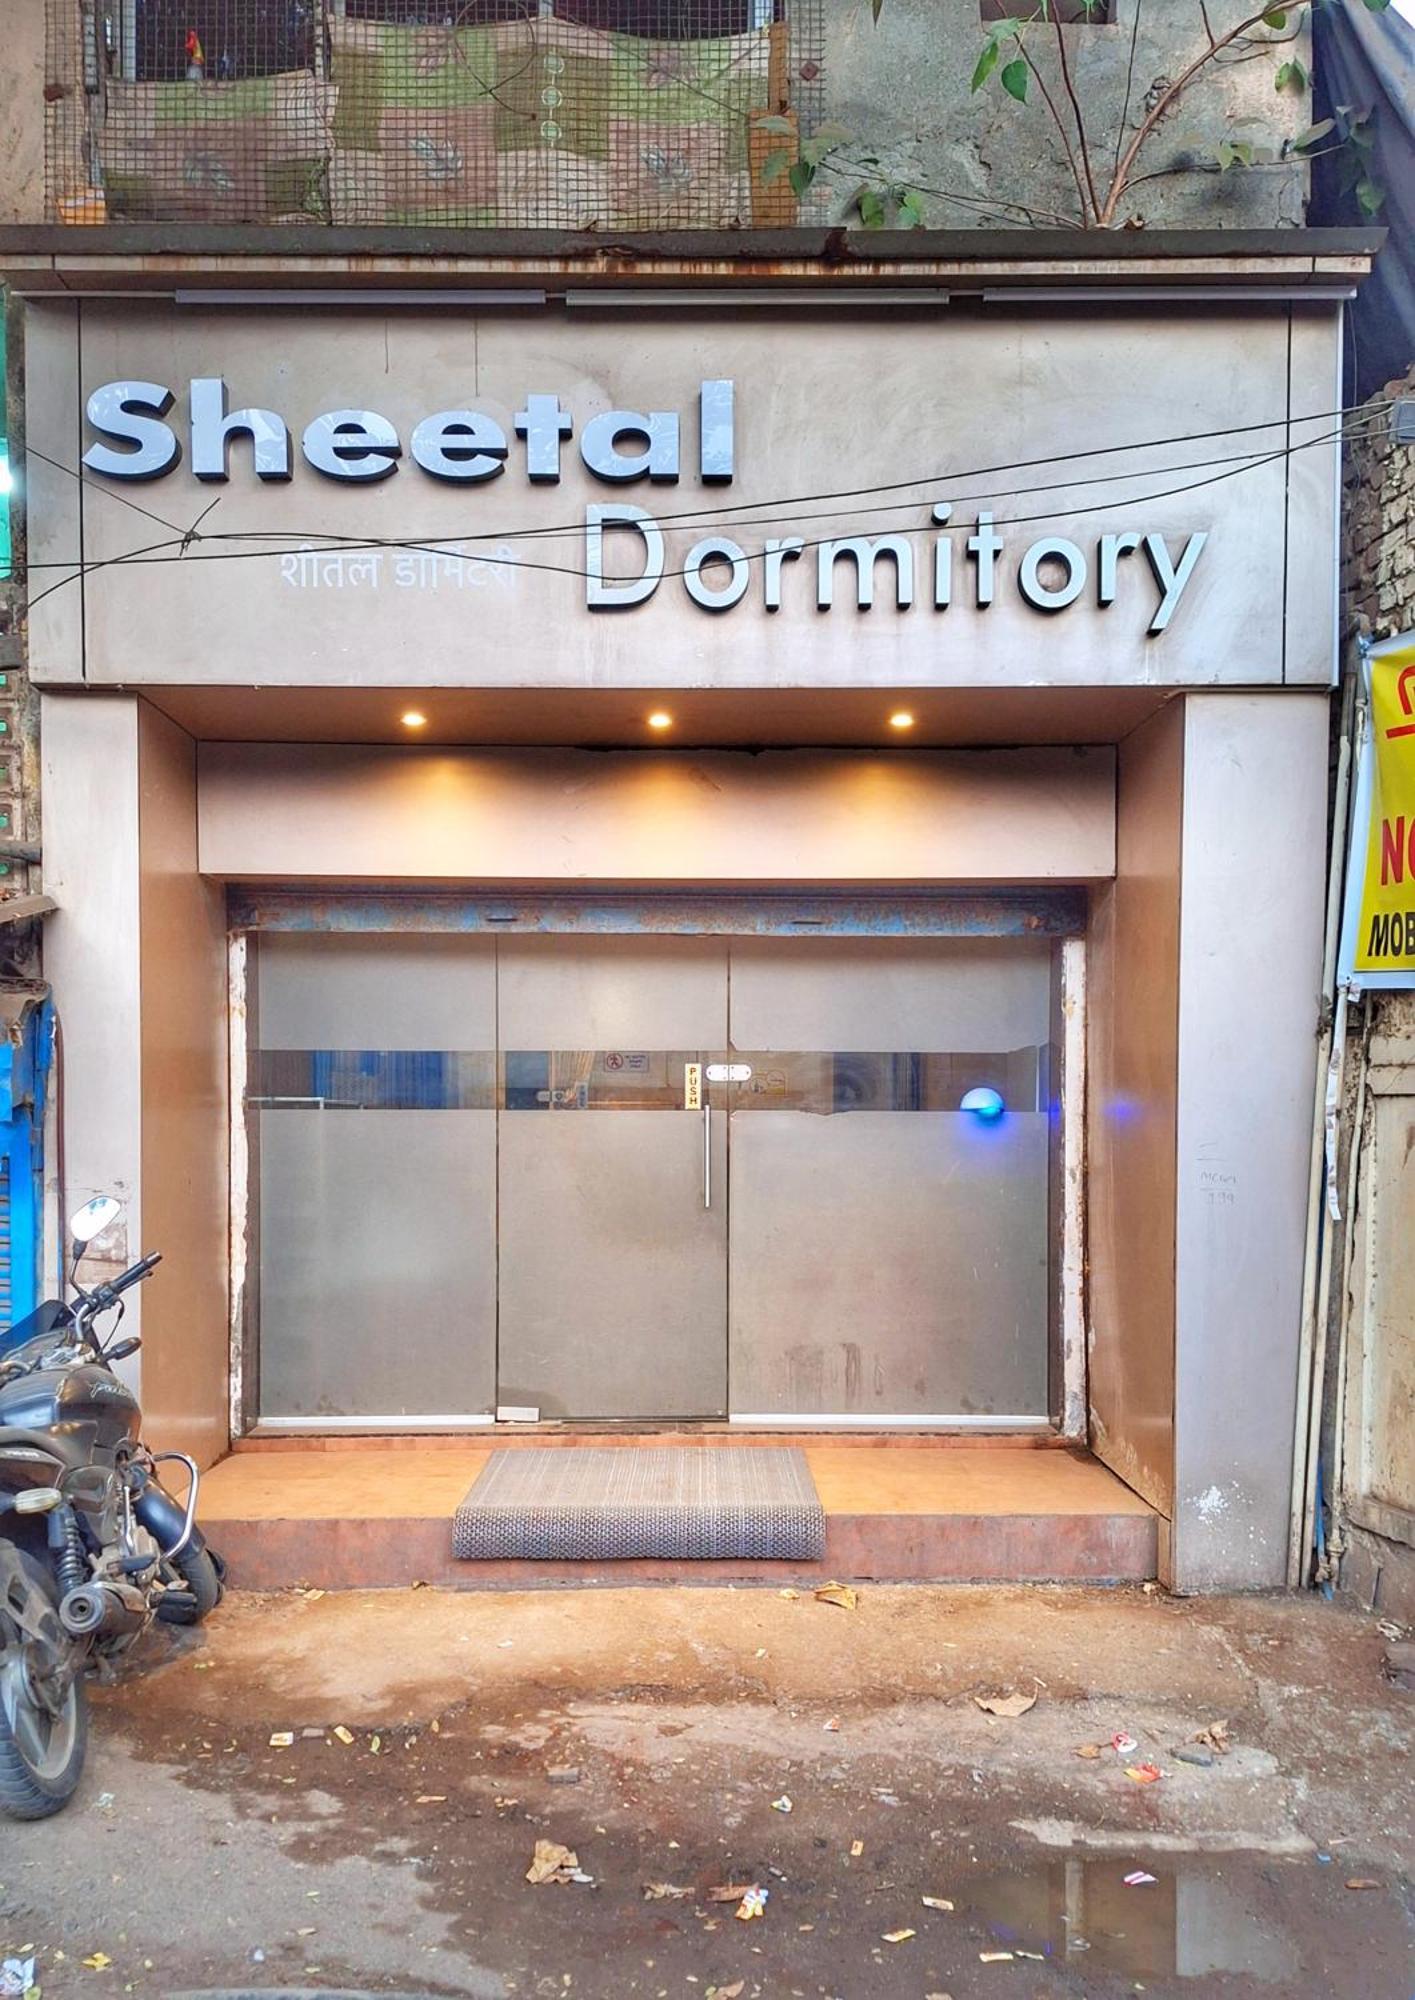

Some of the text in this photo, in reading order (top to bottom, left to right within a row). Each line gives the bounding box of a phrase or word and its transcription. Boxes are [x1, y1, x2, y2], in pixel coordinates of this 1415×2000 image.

[82, 378, 735, 485] Sheetal
[280, 543, 383, 588] शीतल
[585, 503, 1208, 636] Dormitory
[689, 1067, 698, 1105] PUSH
